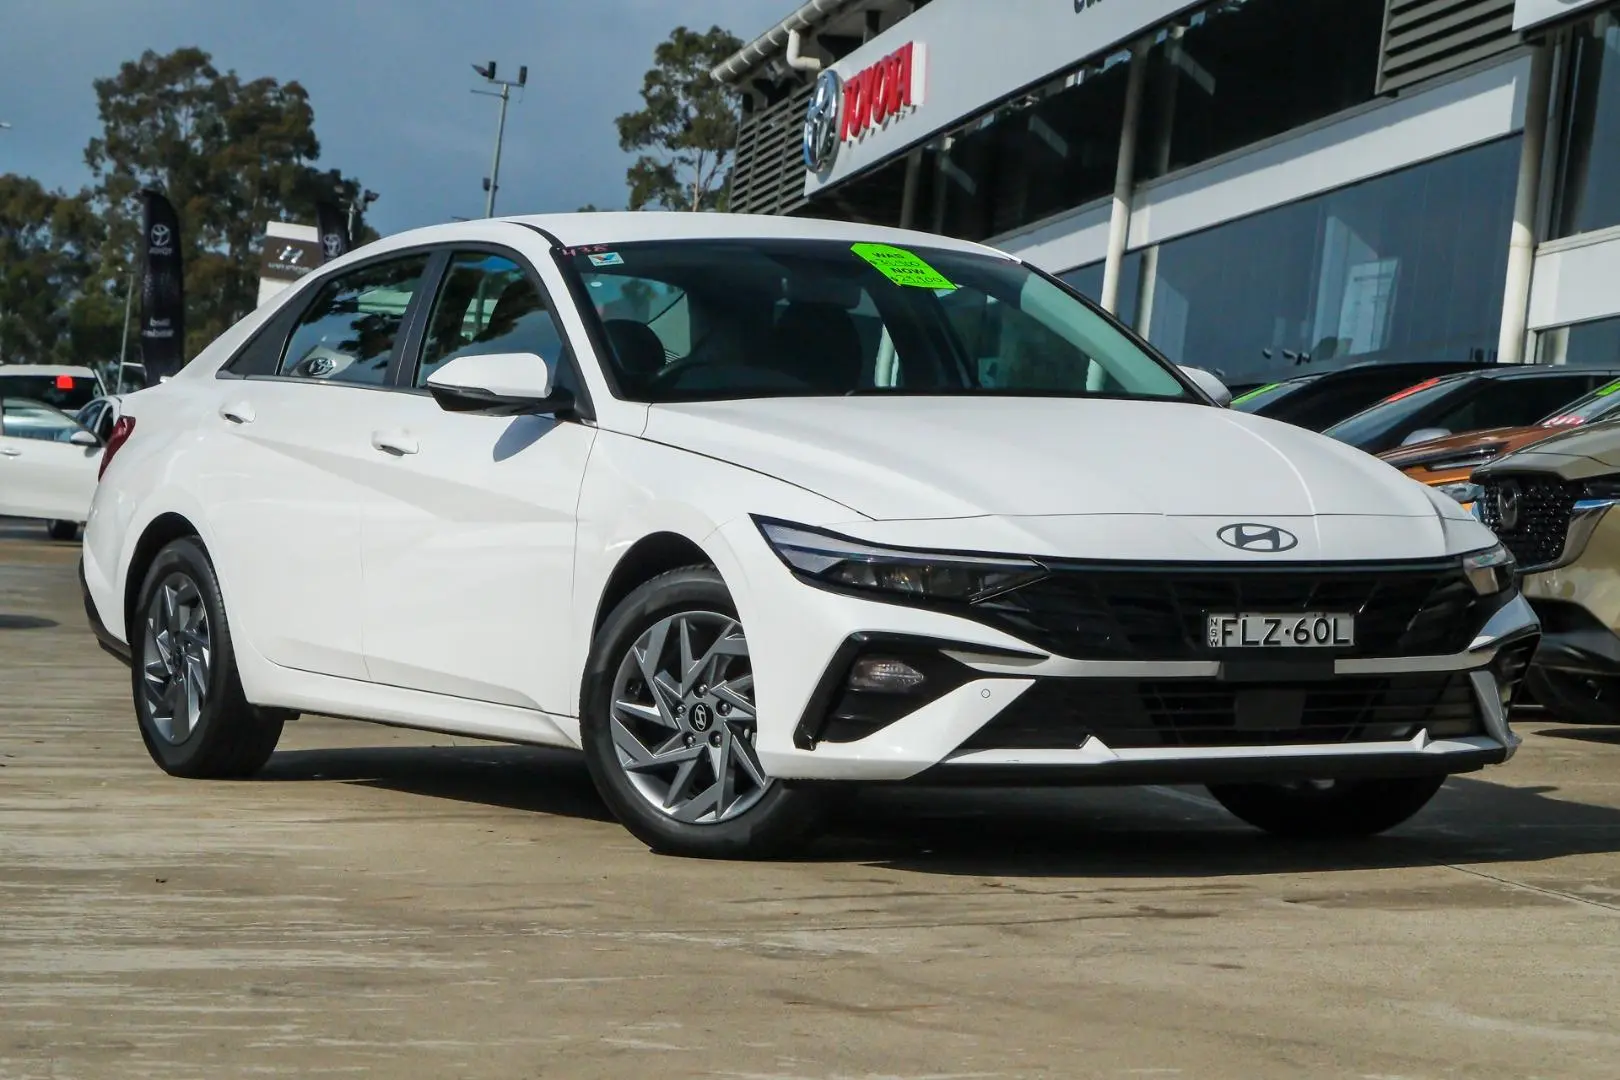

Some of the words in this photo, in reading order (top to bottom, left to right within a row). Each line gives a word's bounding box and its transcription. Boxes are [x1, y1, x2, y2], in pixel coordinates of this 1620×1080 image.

[840, 41, 914, 143] TOYOTA
[890, 267, 926, 275] NOW
[1209, 618, 1219, 646] NSW
